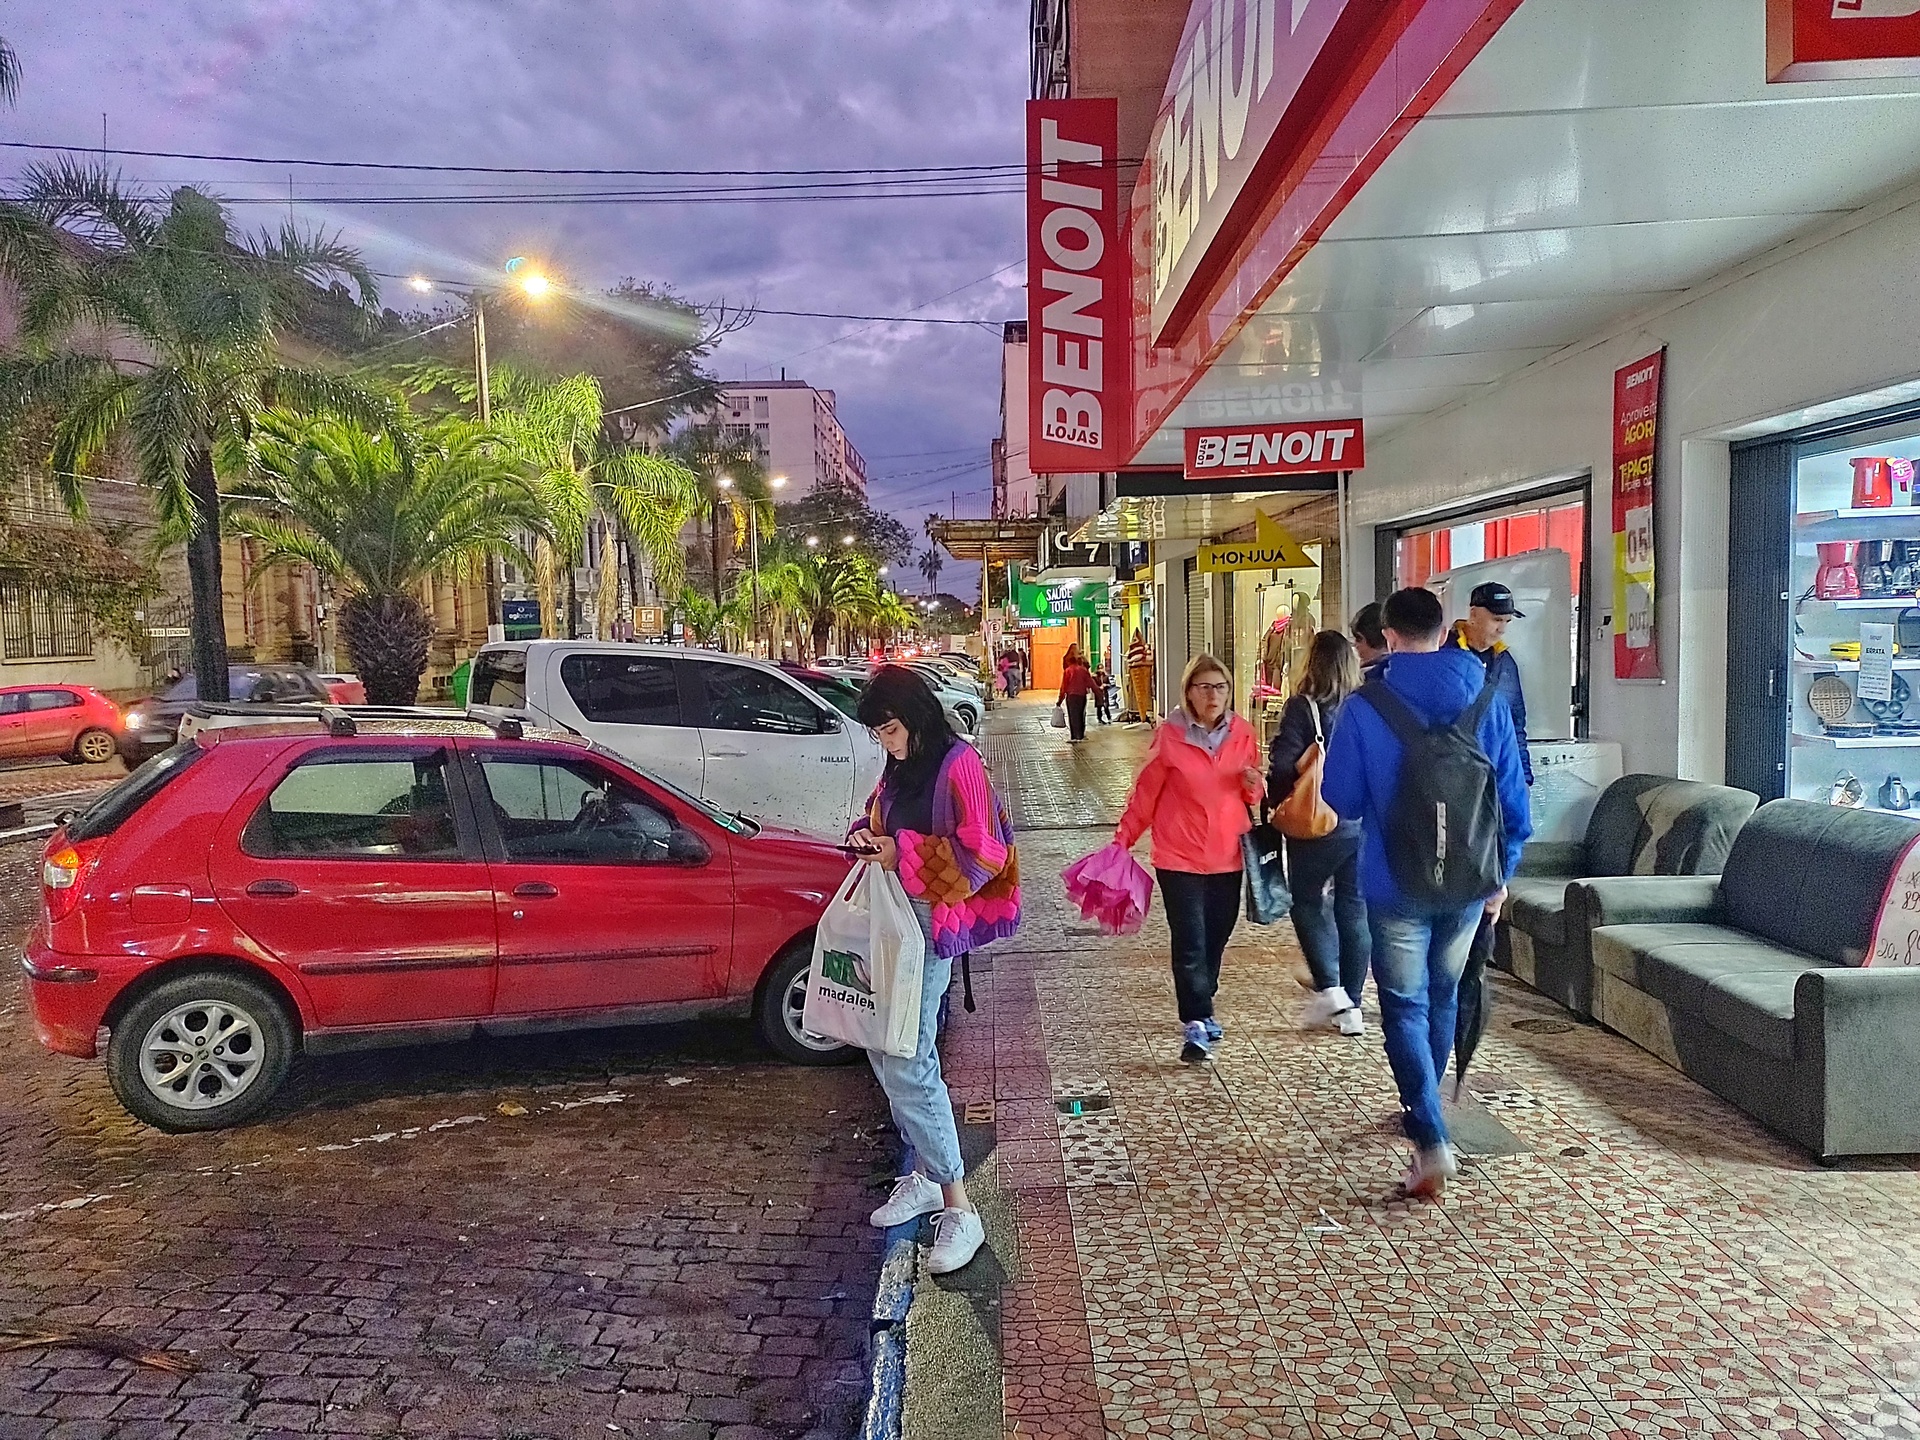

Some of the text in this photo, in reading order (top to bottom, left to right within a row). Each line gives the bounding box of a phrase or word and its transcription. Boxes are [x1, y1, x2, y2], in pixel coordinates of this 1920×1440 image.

[1041, 117, 1105, 450] BENOIT
[1625, 365, 1655, 389] BENOIT
[1046, 422, 1099, 445] LOJAS
[1195, 428, 1355, 468] BENOIT
[1197, 438, 1208, 466] LOJAS
[1085, 543, 1100, 563] 7
[1211, 545, 1286, 565] MONJUÁ
[1046, 585, 1073, 601] SAÚDE
[1050, 599, 1074, 613] TOTAL
